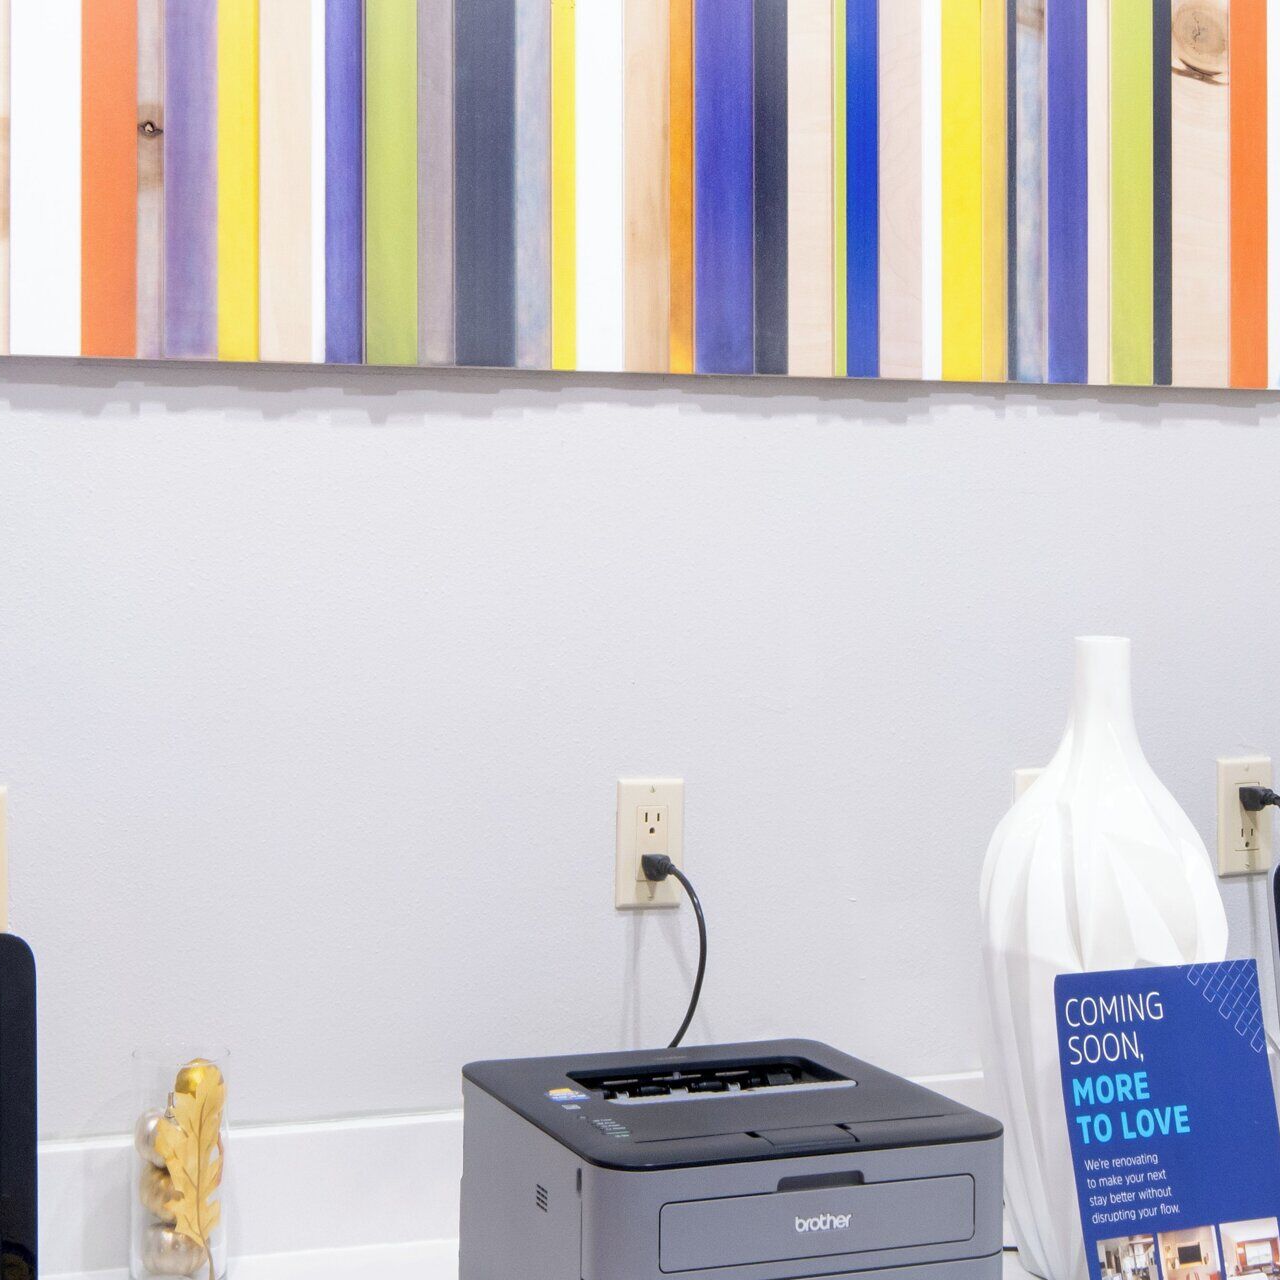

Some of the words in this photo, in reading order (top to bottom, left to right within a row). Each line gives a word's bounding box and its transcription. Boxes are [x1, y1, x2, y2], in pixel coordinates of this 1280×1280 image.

[1065, 992, 1164, 1027] COMING
[1068, 1031, 1144, 1065] SOON,
[1072, 1071, 1150, 1106] MORE
[1076, 1113, 1113, 1144] TO
[1120, 1104, 1191, 1140] LOVE
[1084, 1158, 1110, 1171] We're
[1112, 1153, 1158, 1168] renovating
[1087, 1178, 1097, 1189] to
[1099, 1174, 1123, 1187] make
[1125, 1173, 1145, 1185] your
[1147, 1169, 1167, 1180] next
[1089, 1195, 1108, 1207] stay
[1110, 1192, 1136, 1204] better
[1138, 1186, 1172, 1200] without
[795, 1213, 851, 1232] brother
[1092, 1208, 1136, 1224] disrupting
[1138, 1206, 1158, 1219] your
[1160, 1203, 1180, 1215] flow.
